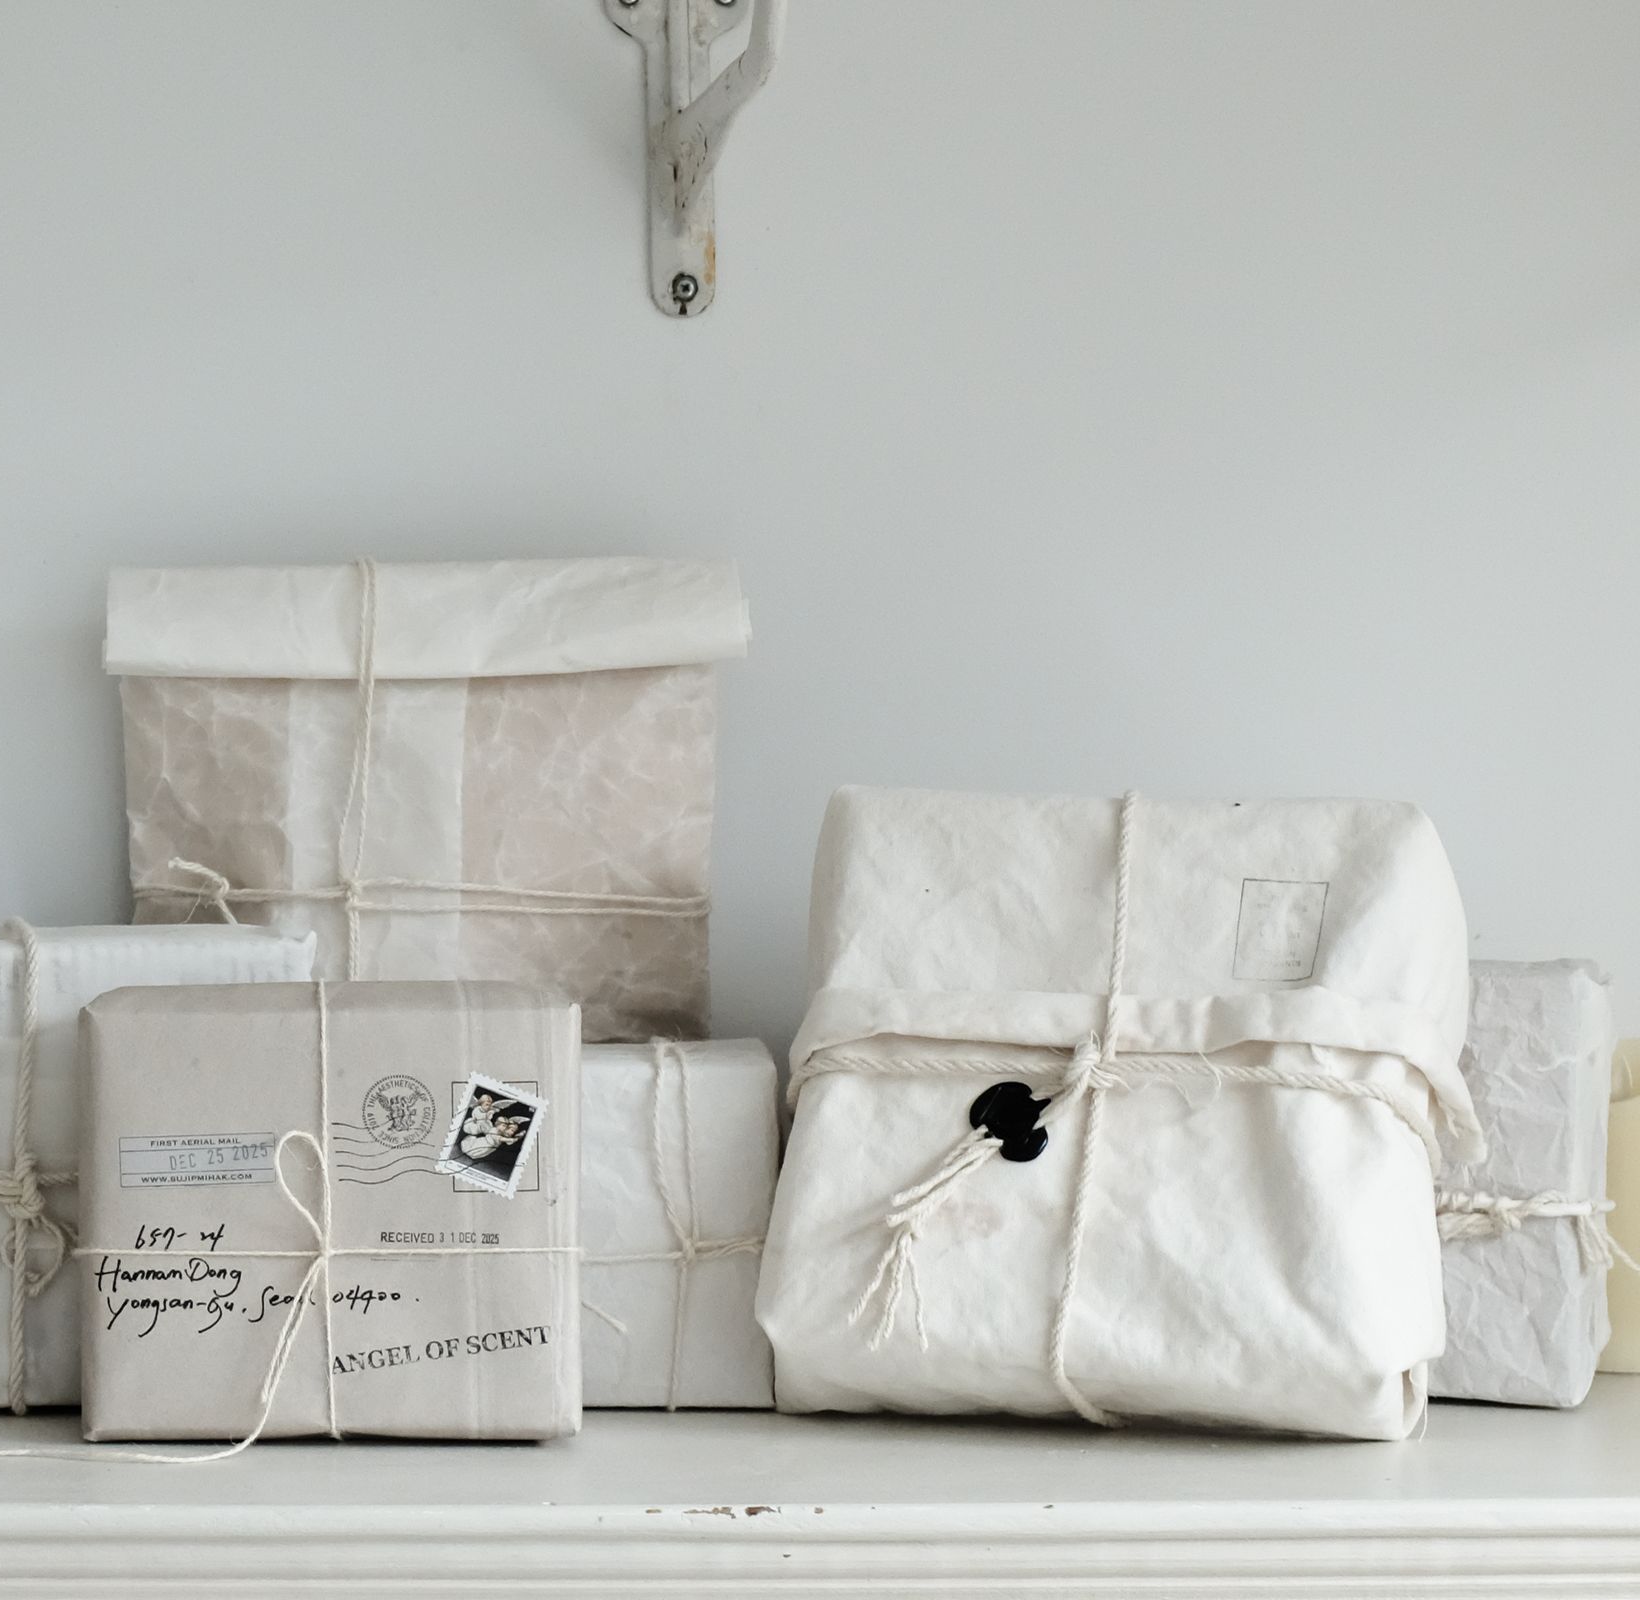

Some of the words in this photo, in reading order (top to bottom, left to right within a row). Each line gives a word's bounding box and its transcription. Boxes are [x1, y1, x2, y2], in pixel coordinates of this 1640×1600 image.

[378, 1079, 420, 1092] AESTHETICS
[150, 1139, 177, 1147] FIRST
[181, 1138, 215, 1146] AERIAL
[218, 1137, 242, 1145] MAIL
[169, 1153, 196, 1171] DEC
[207, 1148, 224, 1165] 25
[232, 1142, 268, 1161] 2025
[380, 1231, 435, 1243] RECEIVED
[459, 1232, 477, 1244] DEC
[481, 1233, 500, 1244] 2025
[331, 1344, 421, 1375] ANGEL
[425, 1337, 460, 1361] OF
[466, 1325, 552, 1355] SCENT
